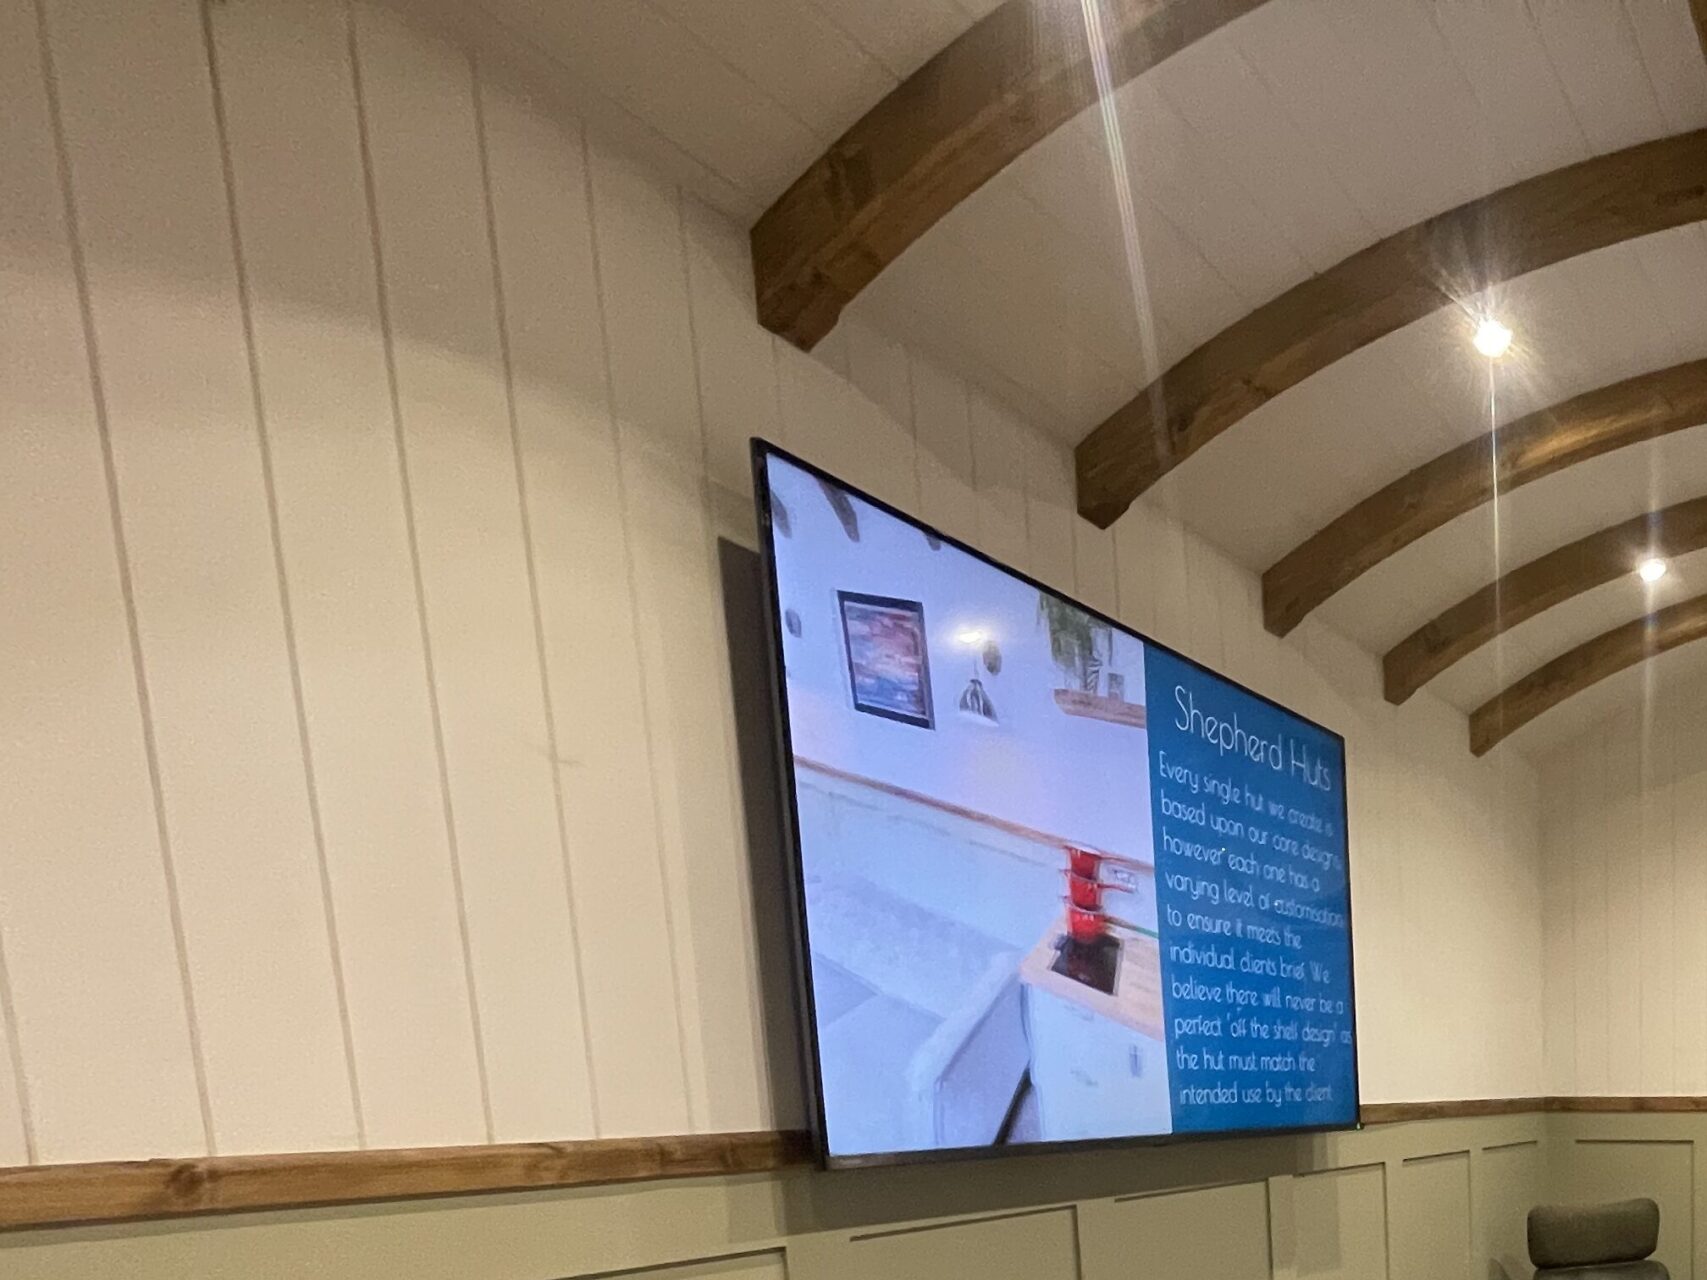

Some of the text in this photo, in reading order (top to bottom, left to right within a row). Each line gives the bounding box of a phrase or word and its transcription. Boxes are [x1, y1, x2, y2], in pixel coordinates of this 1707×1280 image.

[1175, 685, 1331, 791] Shepherd Huts
[1159, 751, 1198, 794] Every
[1203, 773, 1240, 804] single
[1245, 784, 1264, 811] hut
[1160, 789, 1206, 826] based
[1210, 814, 1245, 838] upon
[1248, 826, 1268, 844] our
[1273, 835, 1299, 856] core
[1228, 849, 1259, 876] each
[1263, 864, 1286, 883] one
[1289, 864, 1309, 889] has
[1165, 871, 1219, 904] varying
[1223, 879, 1254, 908] level
[1258, 892, 1271, 910] of
[1167, 904, 1182, 927] to
[1187, 912, 1231, 936] ensure
[1247, 925, 1281, 946] meets
[1284, 925, 1302, 949] the
[1169, 940, 1236, 971] individual
[1309, 961, 1330, 984] We
[1172, 974, 1222, 1002] believe
[1225, 981, 1258, 1006] there
[1263, 986, 1282, 1008] will
[1285, 995, 1316, 1012] never
[1319, 993, 1333, 1013] be
[1174, 1015, 1223, 1039] perfect
[1250, 1017, 1270, 1039] the
[1176, 1047, 1315, 1072] the hut must match the
[1179, 1081, 1238, 1105] intended
[1242, 1087, 1262, 1103] use
[1266, 1080, 1282, 1107] by
[1285, 1082, 1303, 1102] the
